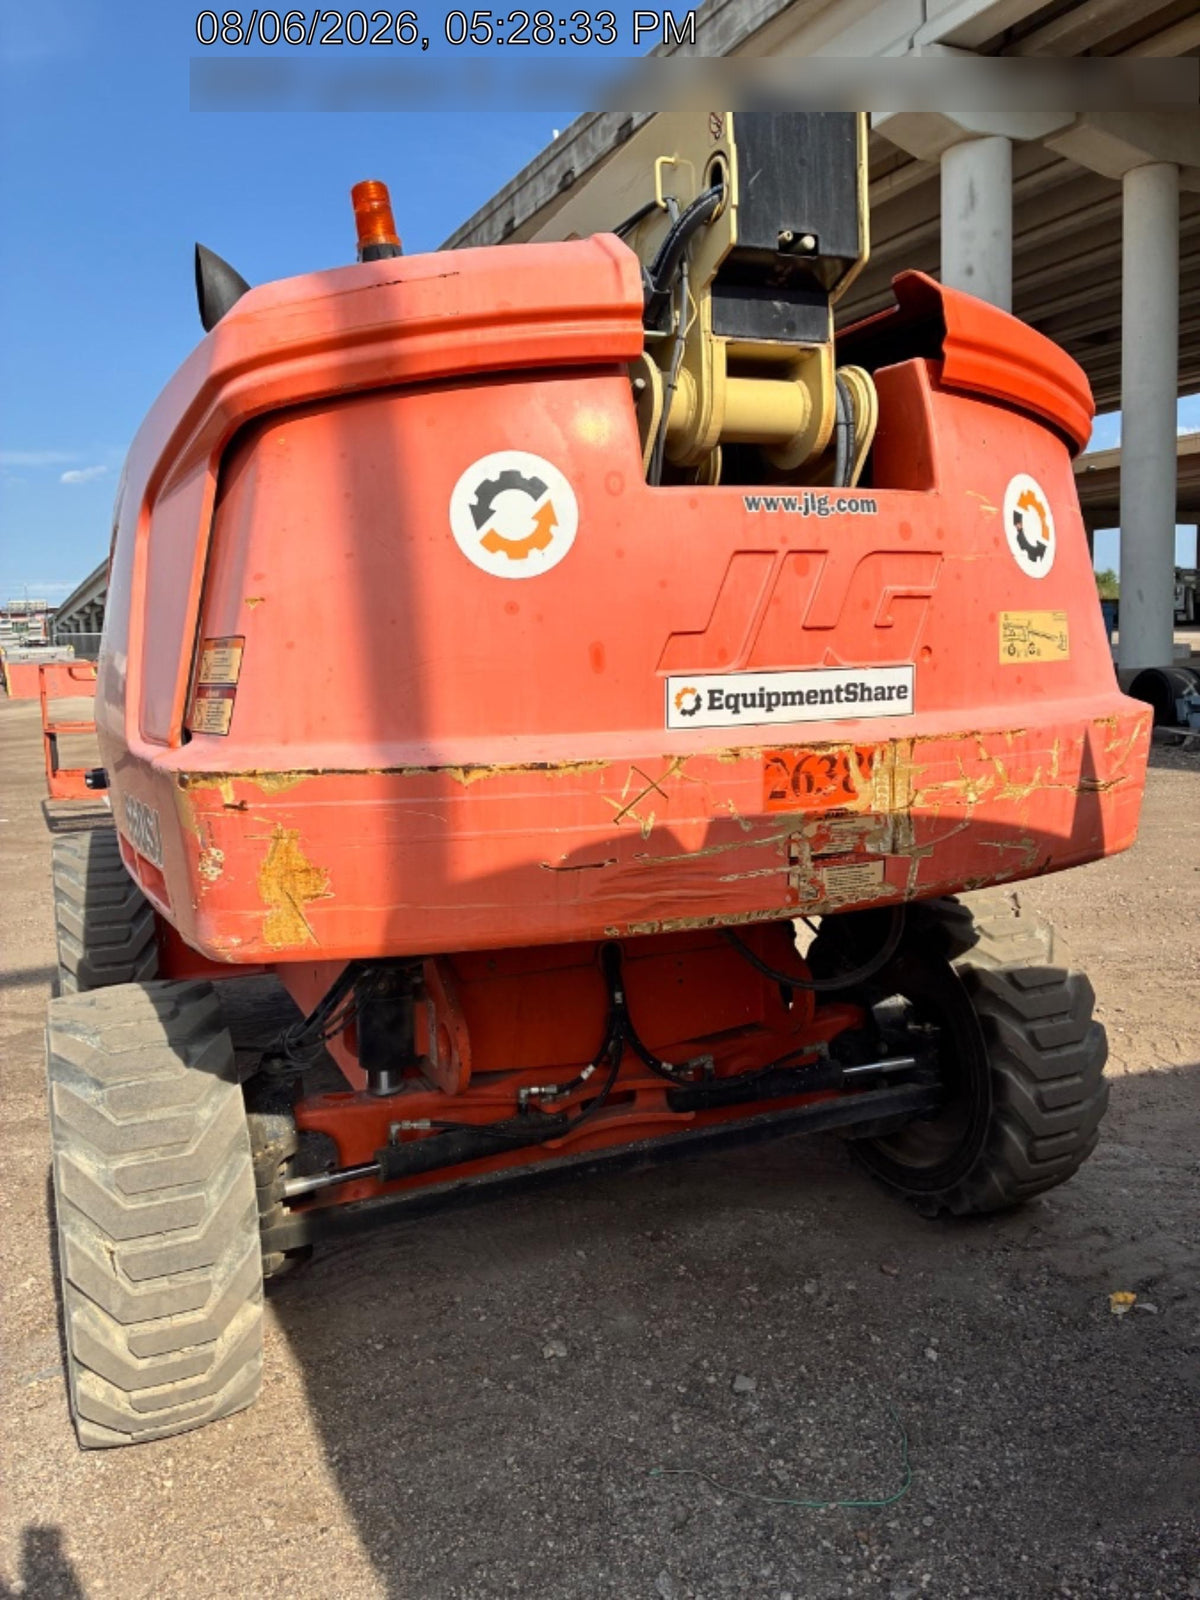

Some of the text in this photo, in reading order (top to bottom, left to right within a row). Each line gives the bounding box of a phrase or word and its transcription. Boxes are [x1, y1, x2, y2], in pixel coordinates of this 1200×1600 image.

[743, 493, 877, 516] www.jlg.com
[656, 550, 943, 673] JLG
[707, 682, 908, 712] EquipmentShare
